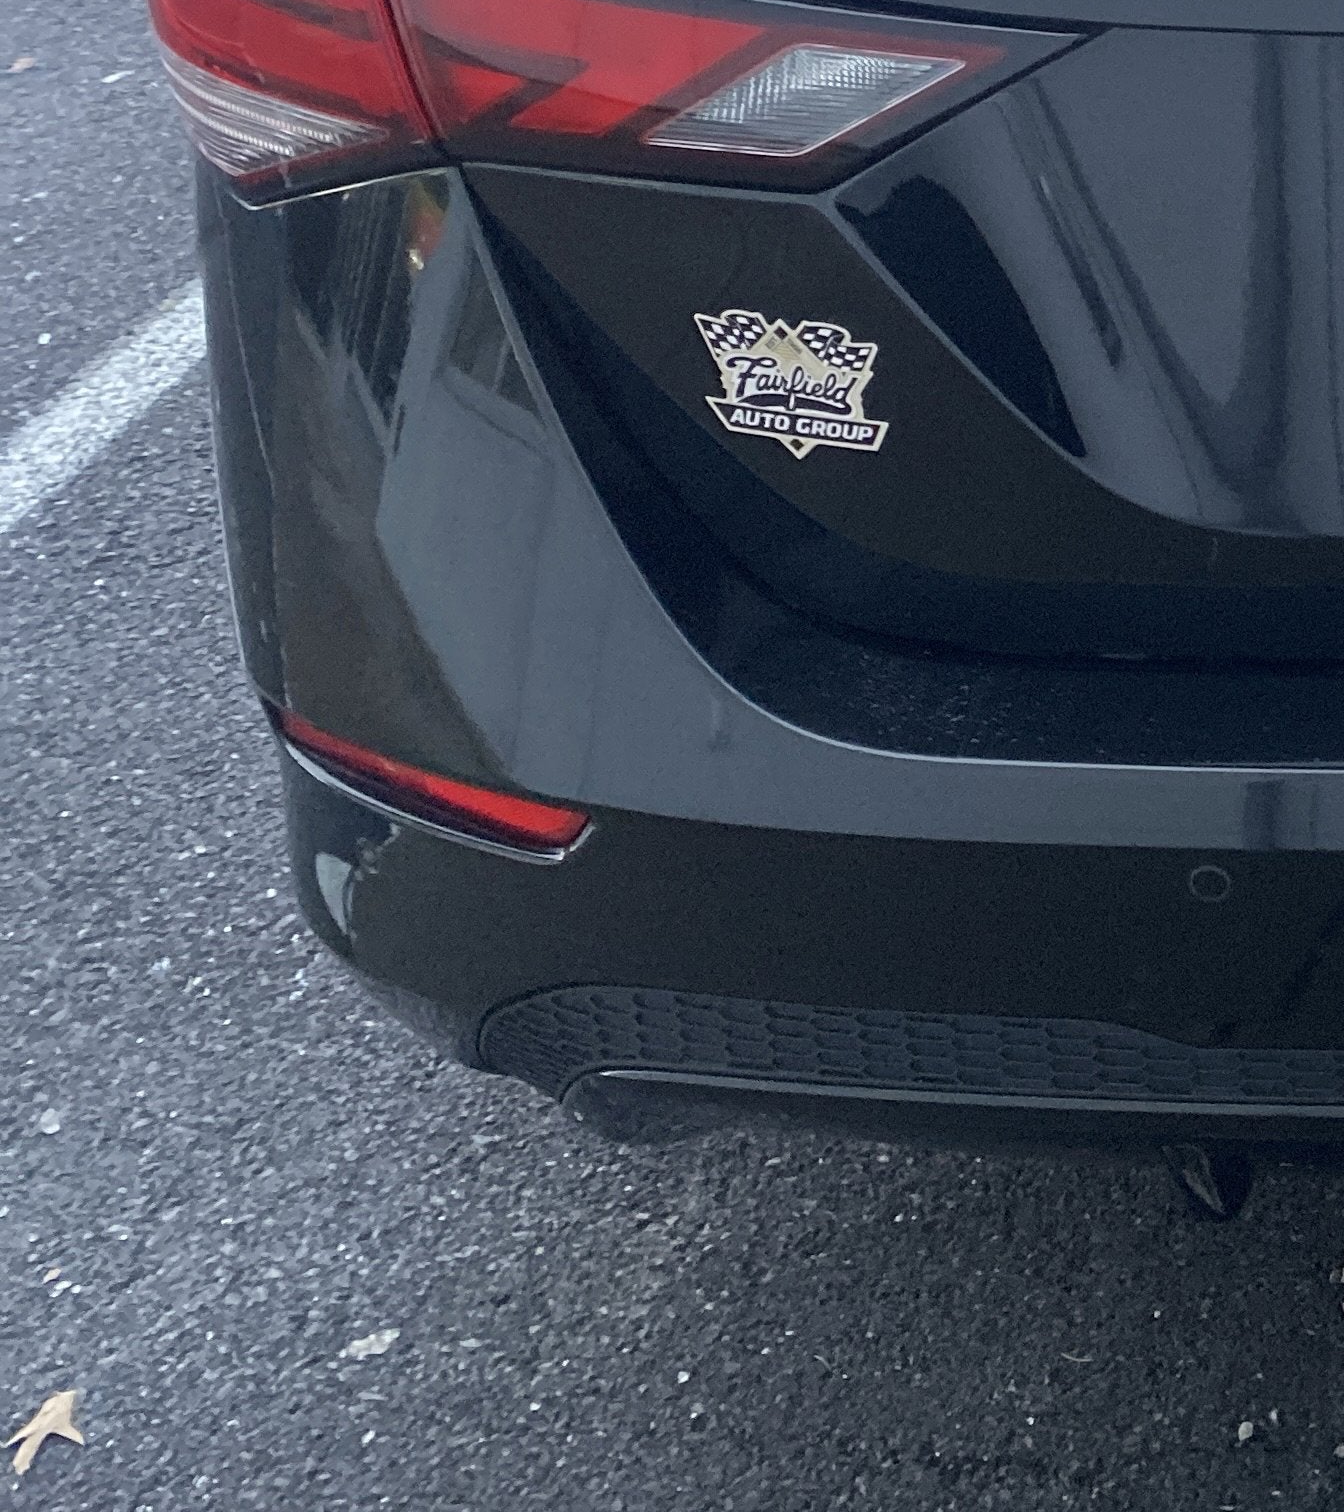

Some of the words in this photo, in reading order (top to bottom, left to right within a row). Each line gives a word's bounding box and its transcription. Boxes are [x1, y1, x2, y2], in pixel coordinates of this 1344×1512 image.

[726, 356, 858, 406] Fairfield
[730, 408, 790, 432] AUTO
[796, 418, 873, 441] GROUP
